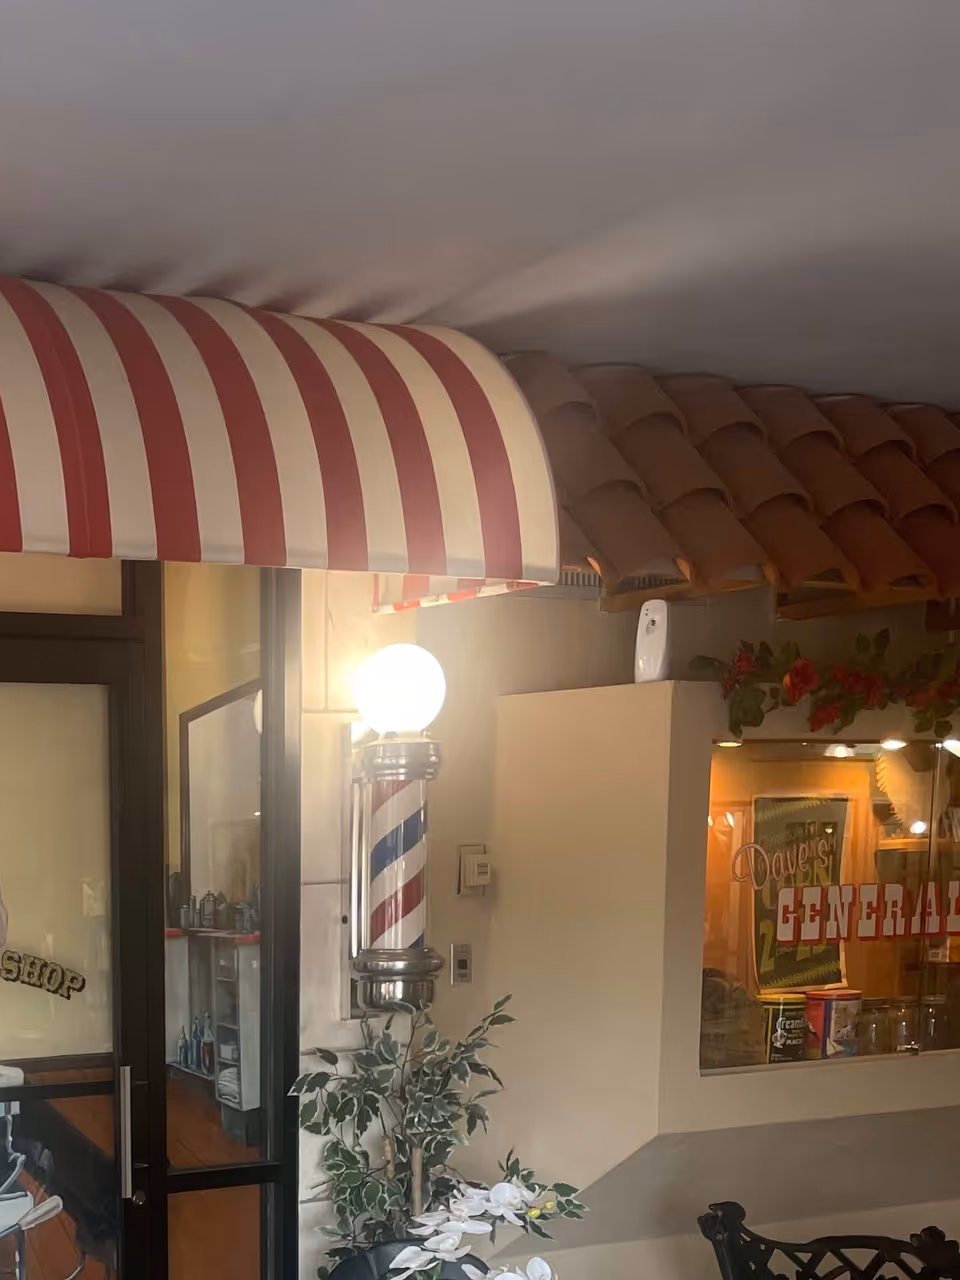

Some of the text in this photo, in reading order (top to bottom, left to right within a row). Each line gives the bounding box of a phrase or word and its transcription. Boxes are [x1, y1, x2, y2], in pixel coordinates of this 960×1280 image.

[732, 839, 830, 890] Dave's
[776, 880, 960, 946] GENERAL
[0, 950, 86, 1000] SHOP
